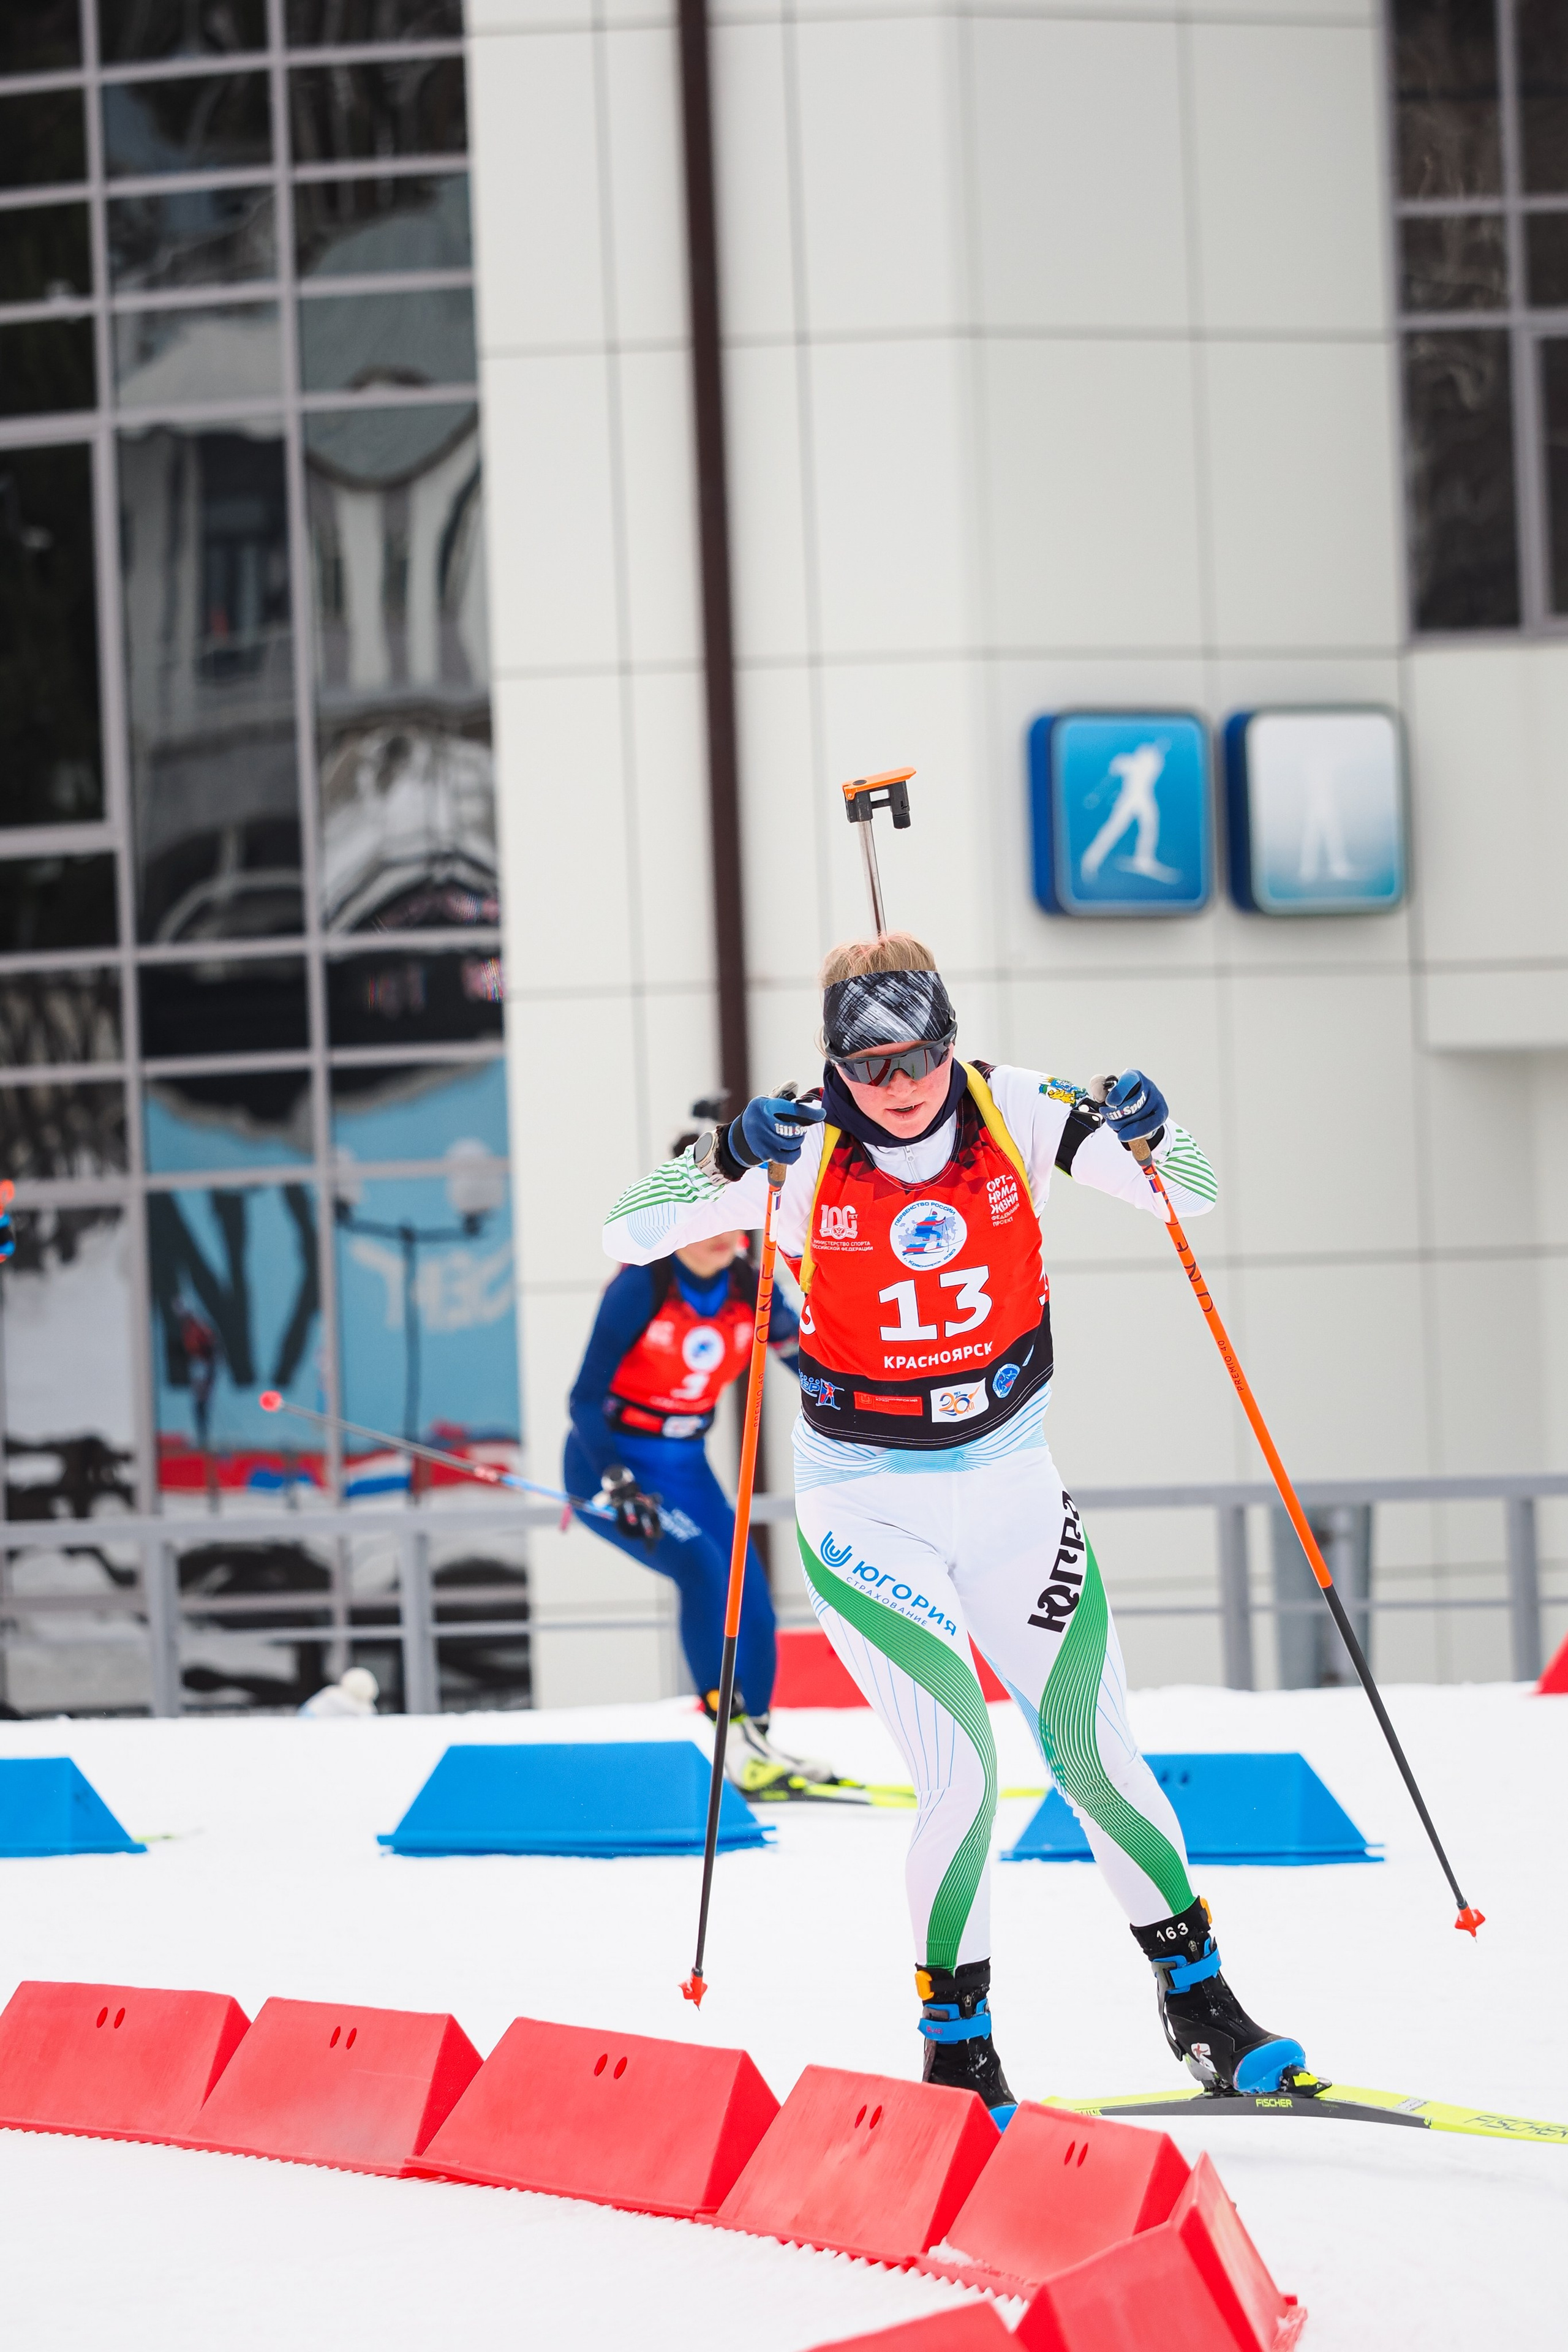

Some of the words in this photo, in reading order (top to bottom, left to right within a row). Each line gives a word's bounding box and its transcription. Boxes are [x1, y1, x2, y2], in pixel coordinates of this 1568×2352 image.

[894, 1202, 929, 1226] ПЕРВЕНСТВО
[931, 1202, 956, 1215] РОССИИ
[878, 1265, 993, 1341] 13
[884, 1341, 993, 1369] КРАСНОЯРСК
[1218, 1340, 1226, 1351] 40
[1224, 1355, 1244, 1391] PREMIO
[846, 1577, 928, 1626] СТРАХОВАНИЕ
[852, 1561, 956, 1636] ЮГОРИЯ
[1156, 1922, 1188, 1942] 163
[1256, 2098, 1293, 2108] FISCHER
